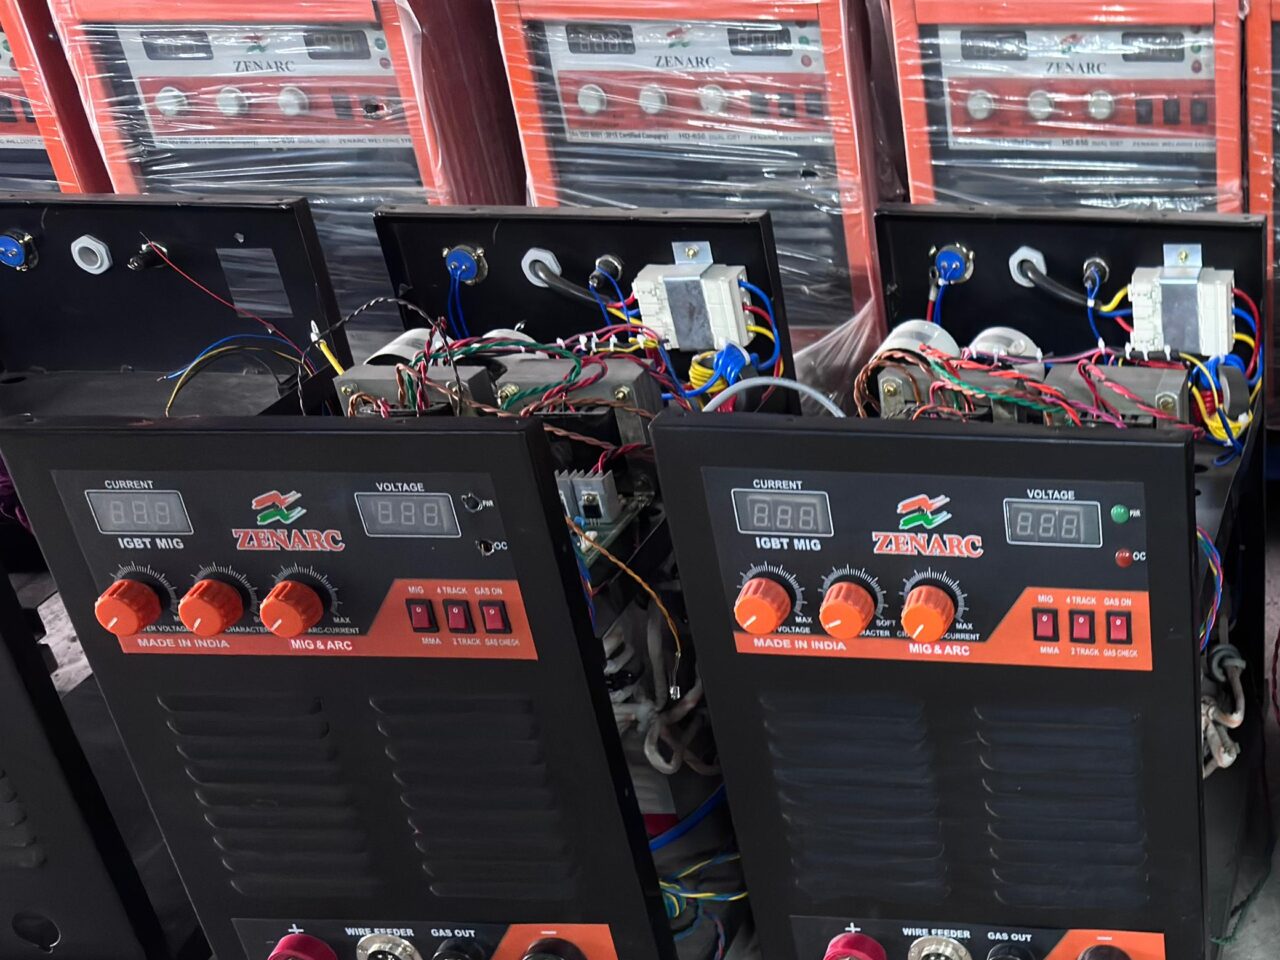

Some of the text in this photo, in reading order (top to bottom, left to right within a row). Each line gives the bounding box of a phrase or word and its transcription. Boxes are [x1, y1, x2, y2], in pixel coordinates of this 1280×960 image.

[233, 60, 296, 73] ZENARC
[654, 55, 716, 68] ZENARC
[1045, 62, 1107, 74] ZENARC
[104, 480, 153, 489] CURRENT
[376, 482, 424, 492] VOLTAGE
[753, 479, 803, 490] CURRENT
[1026, 489, 1075, 500] VOLTAGE
[118, 538, 184, 550] IGBT MIG
[232, 528, 345, 552] ZENARC
[755, 537, 822, 551] IGBT MIG
[872, 531, 984, 558] ZENARC
[1132, 552, 1146, 561] OC
[408, 586, 424, 594] MIG
[442, 586, 468, 595] TRACK
[474, 587, 503, 596] GAS ON
[1038, 594, 1054, 603] MIG
[1072, 596, 1096, 605] TRACK
[1104, 597, 1132, 606] GAS ON
[333, 616, 351, 624] MAX
[795, 616, 812, 624] MAX
[778, 626, 811, 634] VOLTAGE
[956, 622, 974, 630] MAX
[138, 638, 230, 648] MADE IN INDIA
[291, 639, 353, 650] MIG & ARC
[458, 638, 481, 646] TRACK
[754, 638, 847, 650] MADE IN INDIA
[909, 643, 970, 656] MIG & ARC
[1040, 646, 1060, 654] MMA
[1076, 648, 1100, 656] TRACK
[1104, 648, 1138, 658] GAS CHECK
[344, 928, 414, 936] WIRE FEEDER
[430, 928, 476, 938] GAS OUT
[902, 928, 971, 938] WIRE FEEDER
[988, 932, 1032, 942] GAS OUT
